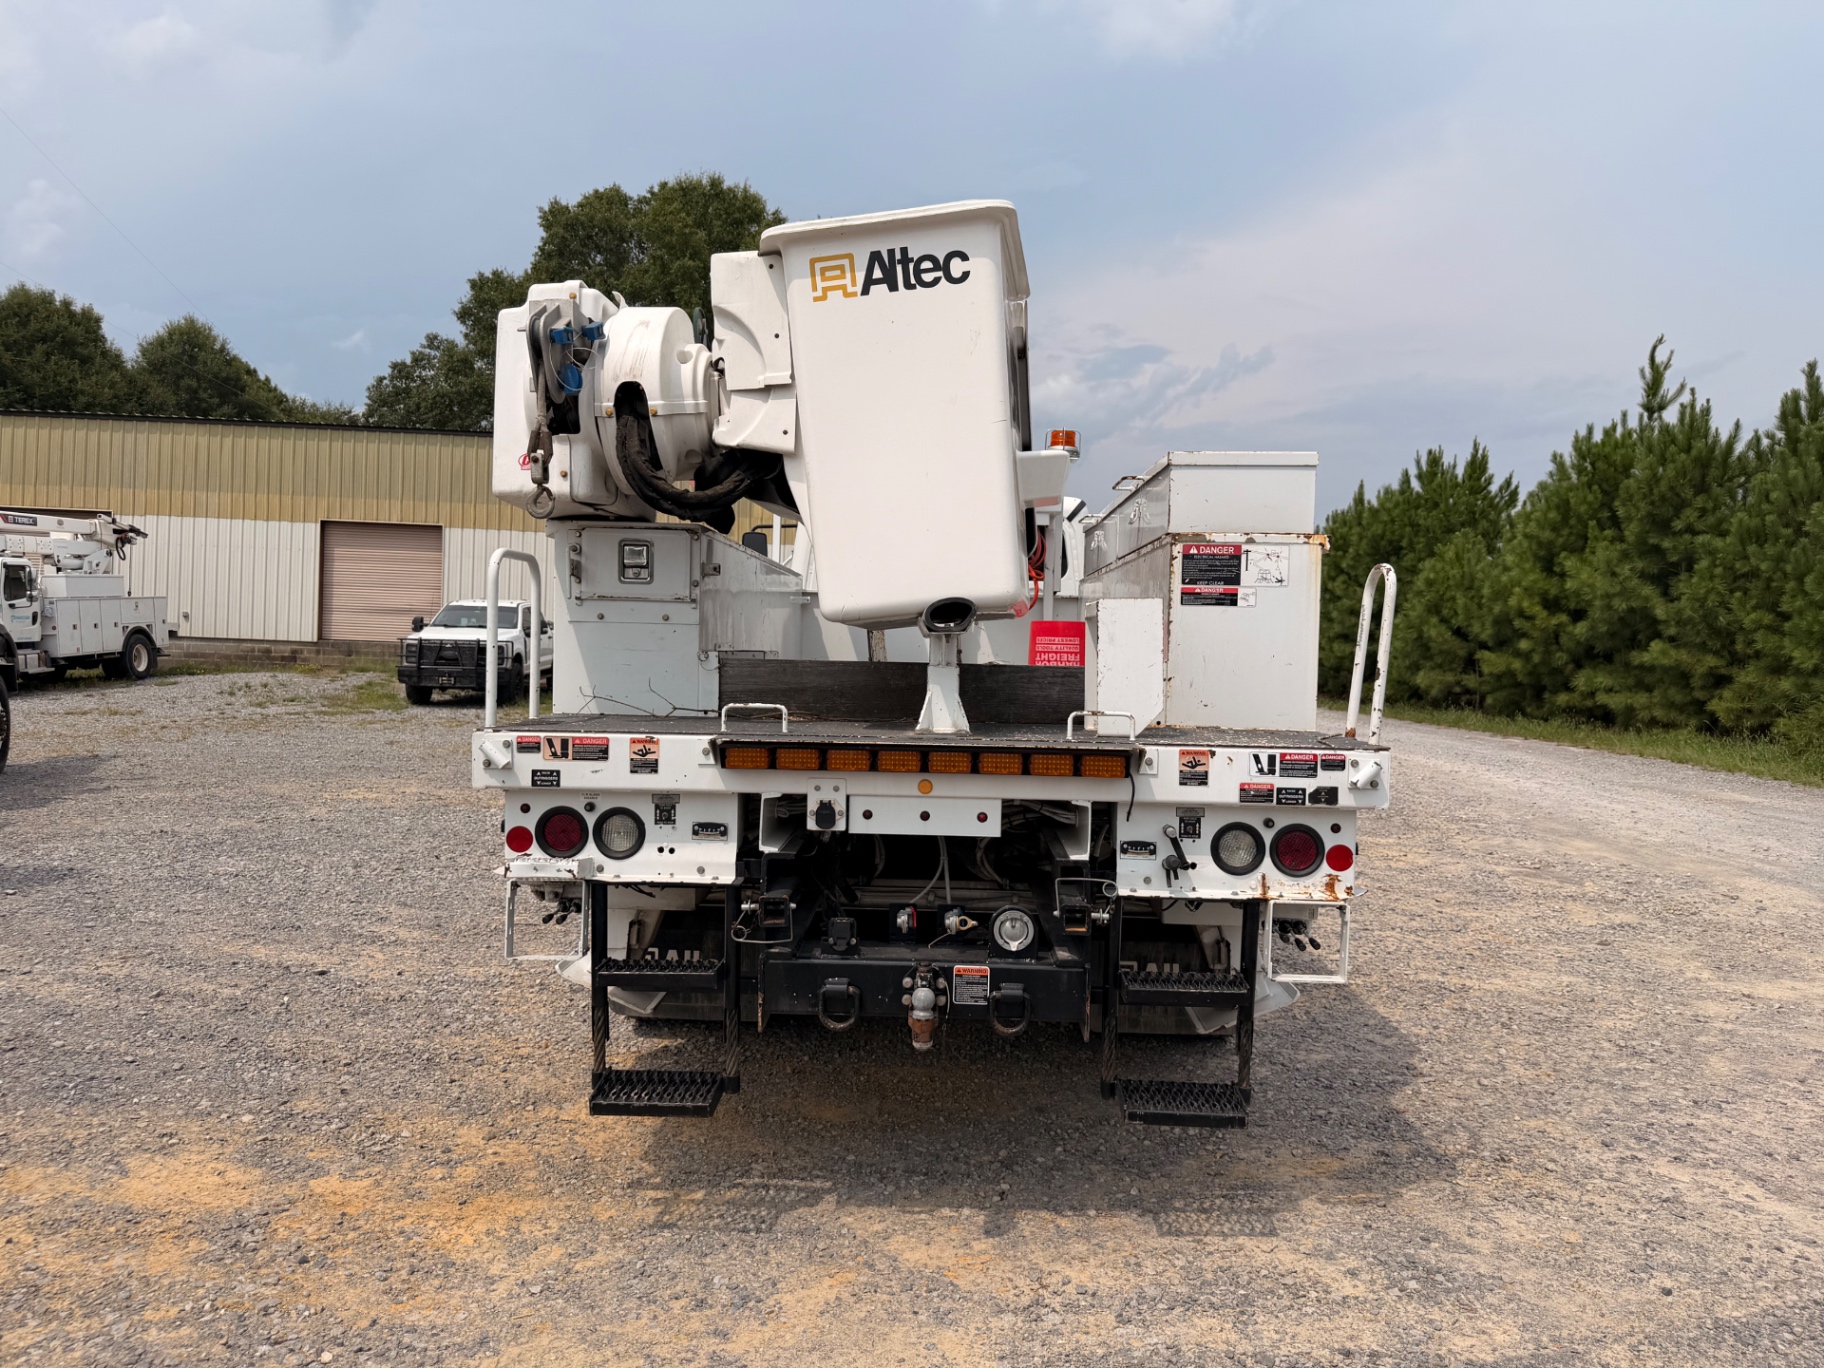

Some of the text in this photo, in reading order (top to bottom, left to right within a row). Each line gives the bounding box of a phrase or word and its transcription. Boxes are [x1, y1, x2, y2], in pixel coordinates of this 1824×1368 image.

[860, 246, 971, 296] Altec
[1199, 546, 1235, 554] DANGER
[1036, 653, 1080, 661] FREIGHT
